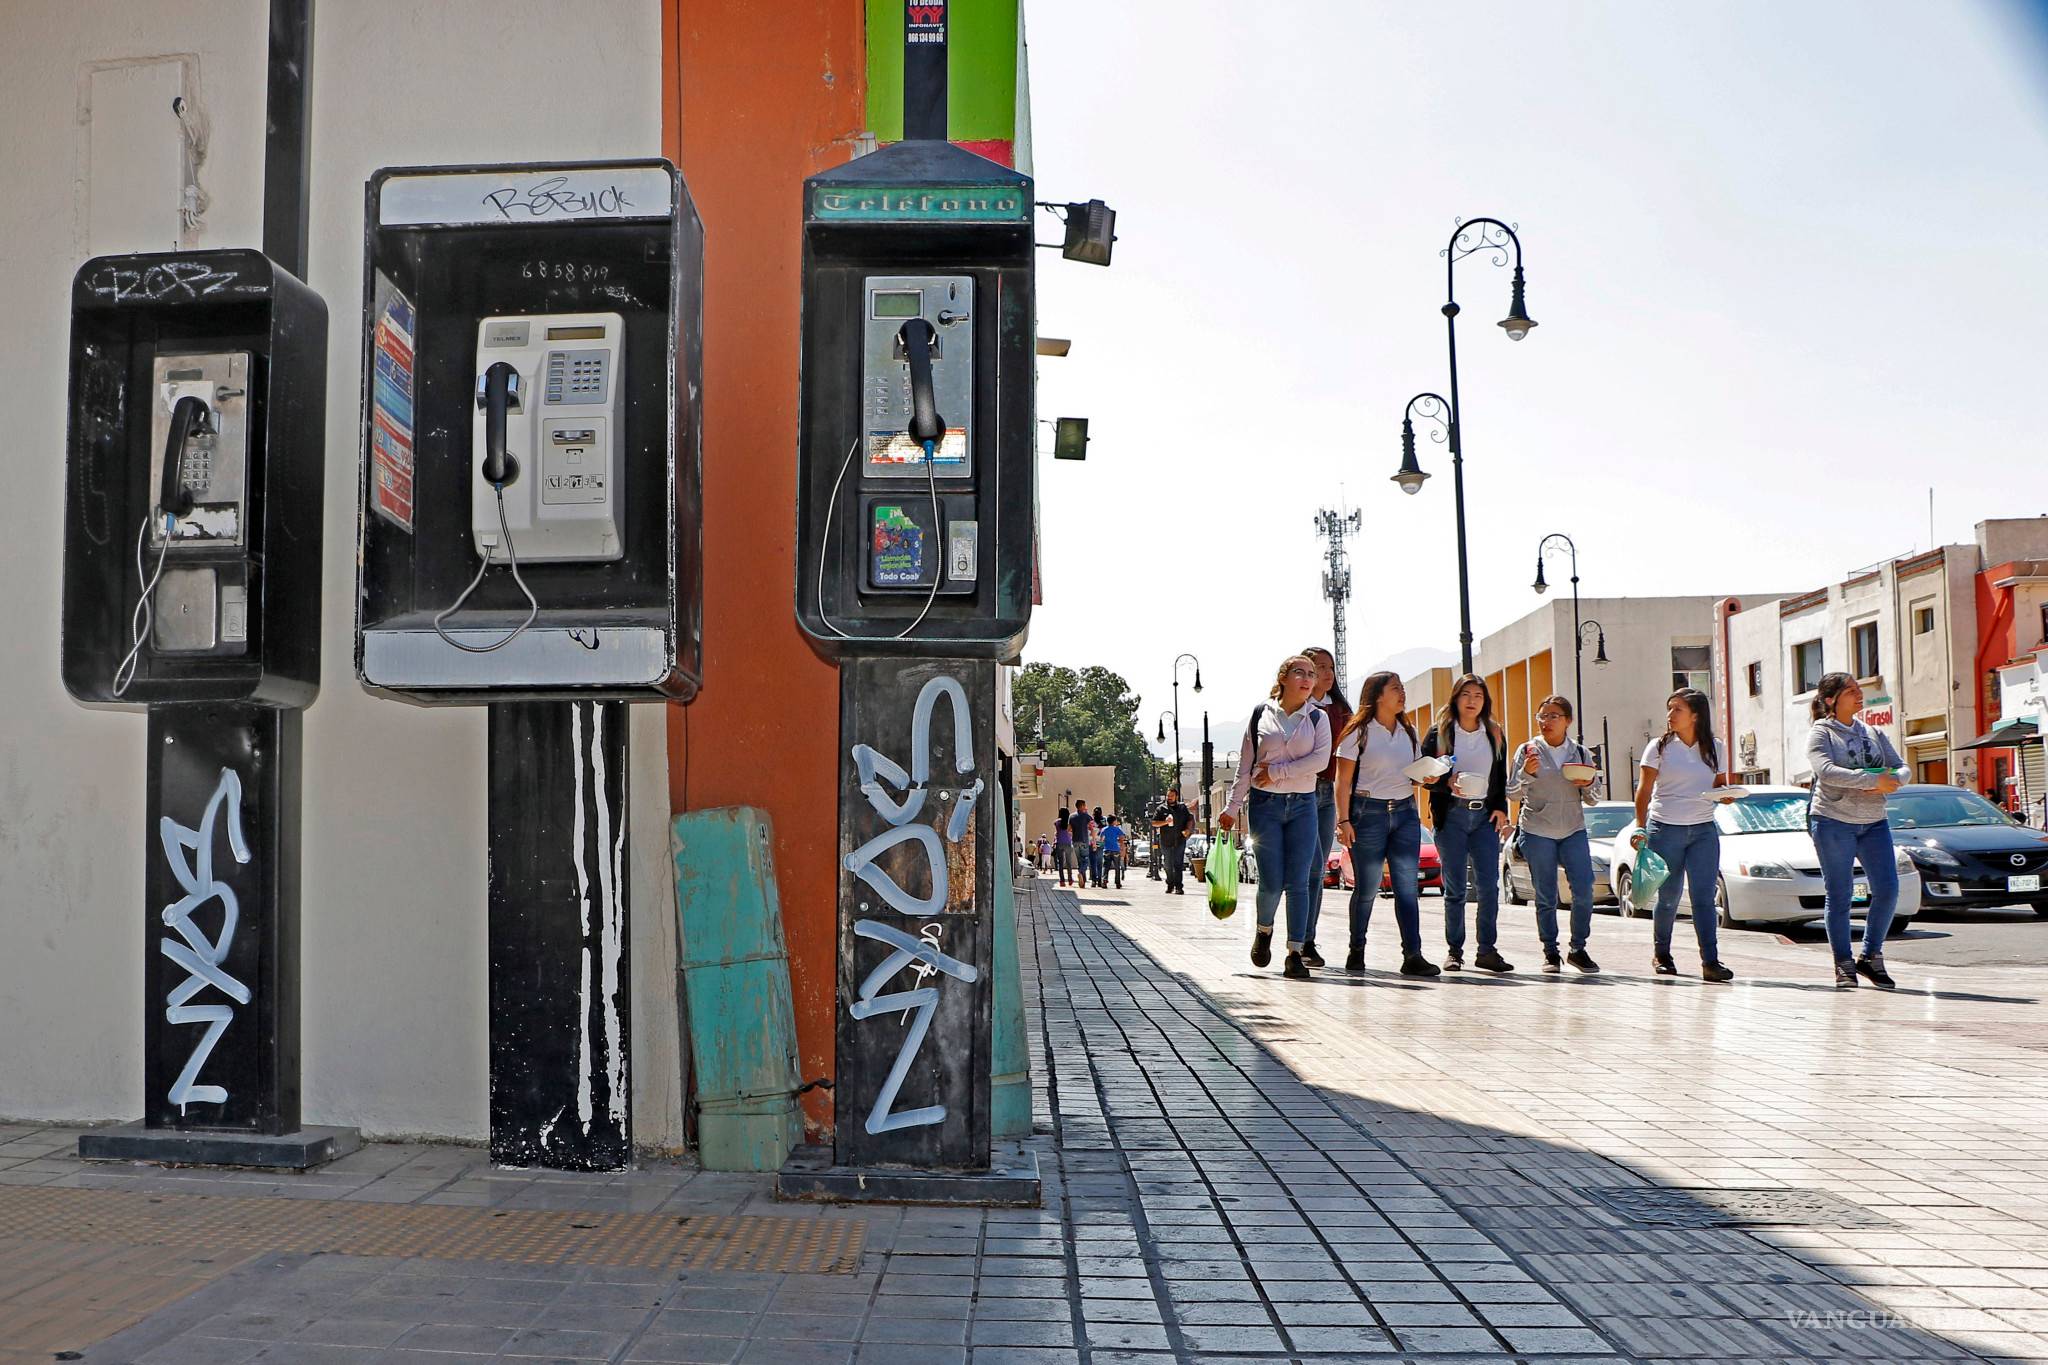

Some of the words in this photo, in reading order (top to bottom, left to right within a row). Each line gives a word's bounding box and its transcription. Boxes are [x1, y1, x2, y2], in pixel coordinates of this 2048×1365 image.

[823, 194, 1015, 211] Teléfono
[880, 572, 898, 580] Todo
[1865, 704, 1893, 726] Girasol
